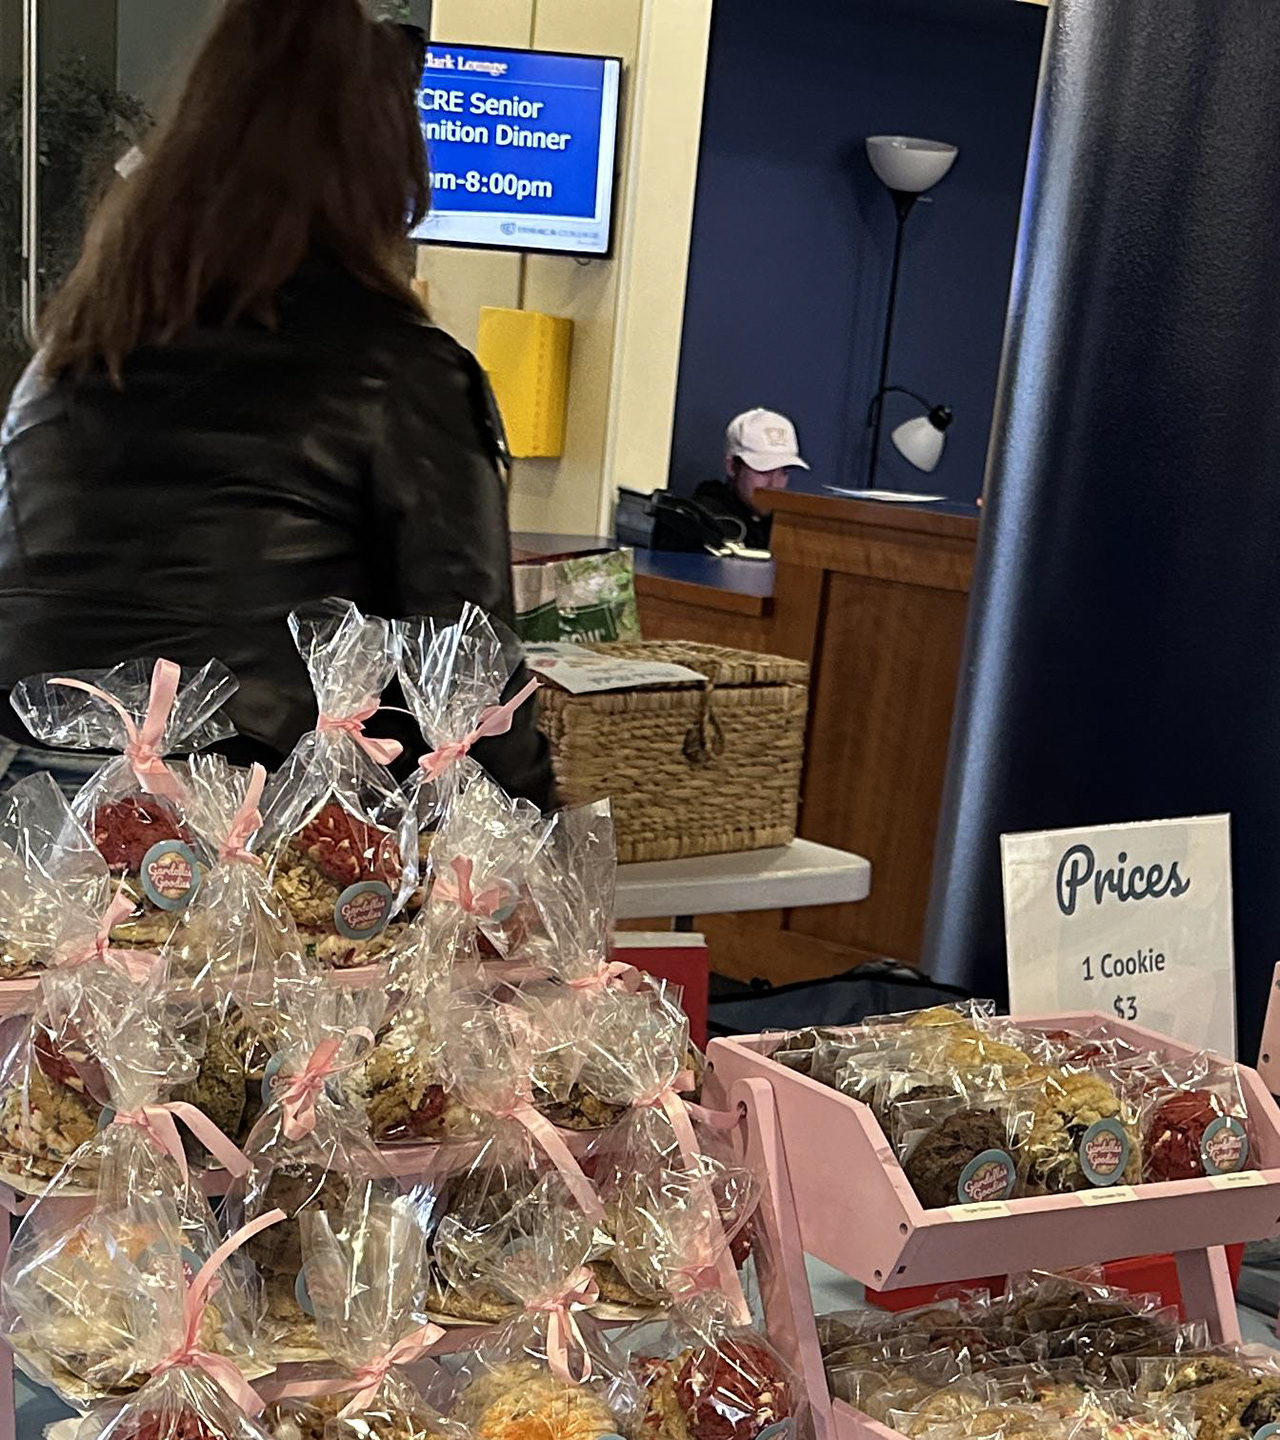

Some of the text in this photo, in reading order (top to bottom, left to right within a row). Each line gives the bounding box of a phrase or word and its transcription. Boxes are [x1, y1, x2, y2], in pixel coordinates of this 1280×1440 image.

[424, 52, 509, 77] lark Lounge
[469, 92, 544, 119] Senior
[424, 119, 572, 151] nition Dinner
[1056, 844, 1191, 916] Prices
[1082, 948, 1166, 981] 1 Cookie
[1113, 993, 1138, 1022] $3
